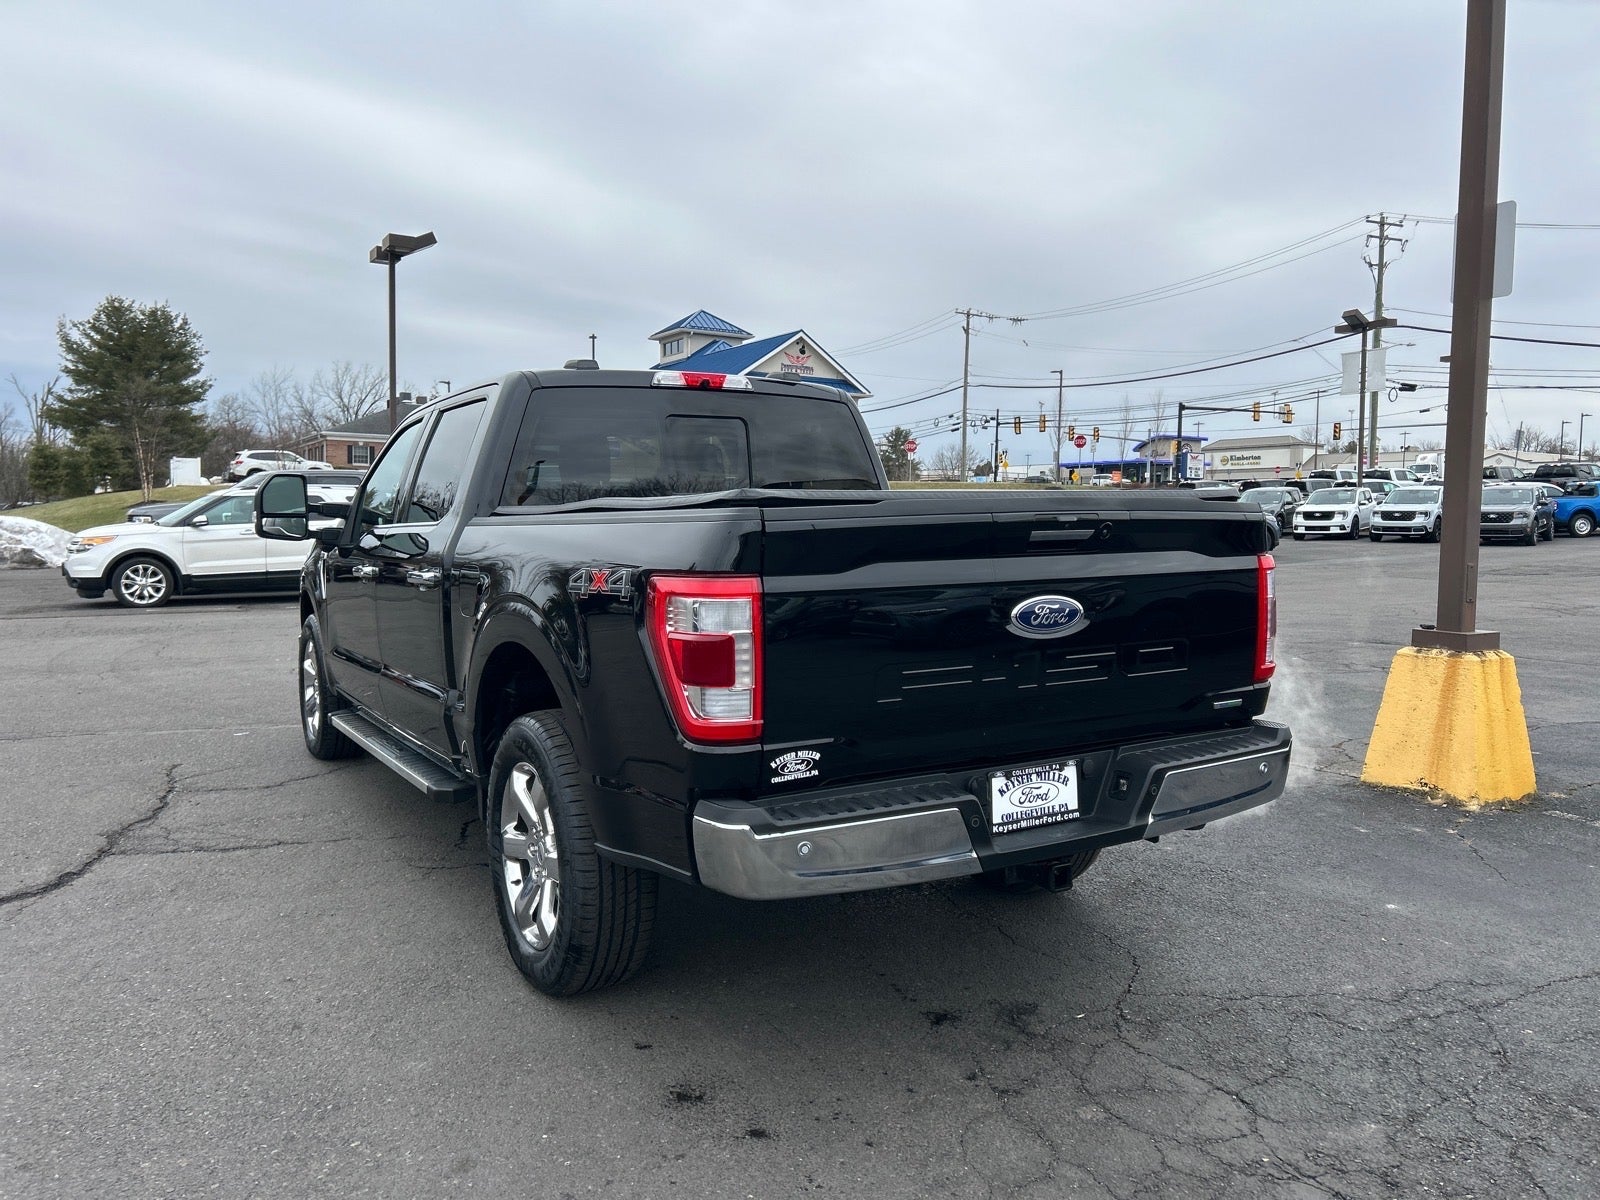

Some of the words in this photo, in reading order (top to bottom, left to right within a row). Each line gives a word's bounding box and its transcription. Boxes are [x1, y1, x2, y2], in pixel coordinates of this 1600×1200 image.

[1030, 603, 1070, 626] Ford
[770, 752, 796, 768] KEYSER
[797, 750, 821, 760] MILLER
[784, 759, 807, 773] Ford
[997, 773, 1033, 798] KEYSER
[1035, 771, 1070, 787] MILLER
[1018, 785, 1051, 805] Ford
[992, 812, 1080, 833] KeyserMillerFord.com
